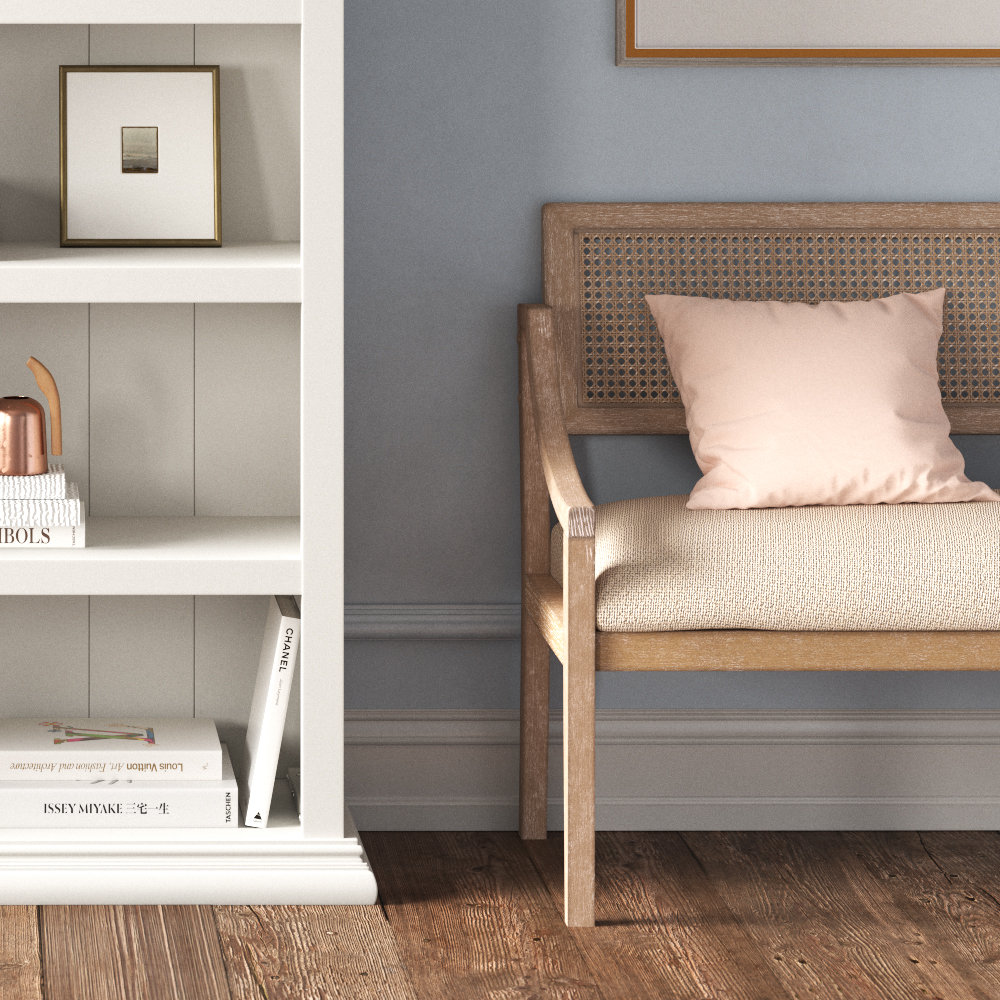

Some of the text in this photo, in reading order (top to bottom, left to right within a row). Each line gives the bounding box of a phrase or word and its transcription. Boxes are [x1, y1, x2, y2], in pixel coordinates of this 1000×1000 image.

[278, 627, 295, 673] CHANEL
[9, 763, 184, 773] Louis Vuitton Art, Fashion and Architecture
[43, 803, 170, 815] ISSEY MIYAKE 三宅一生
